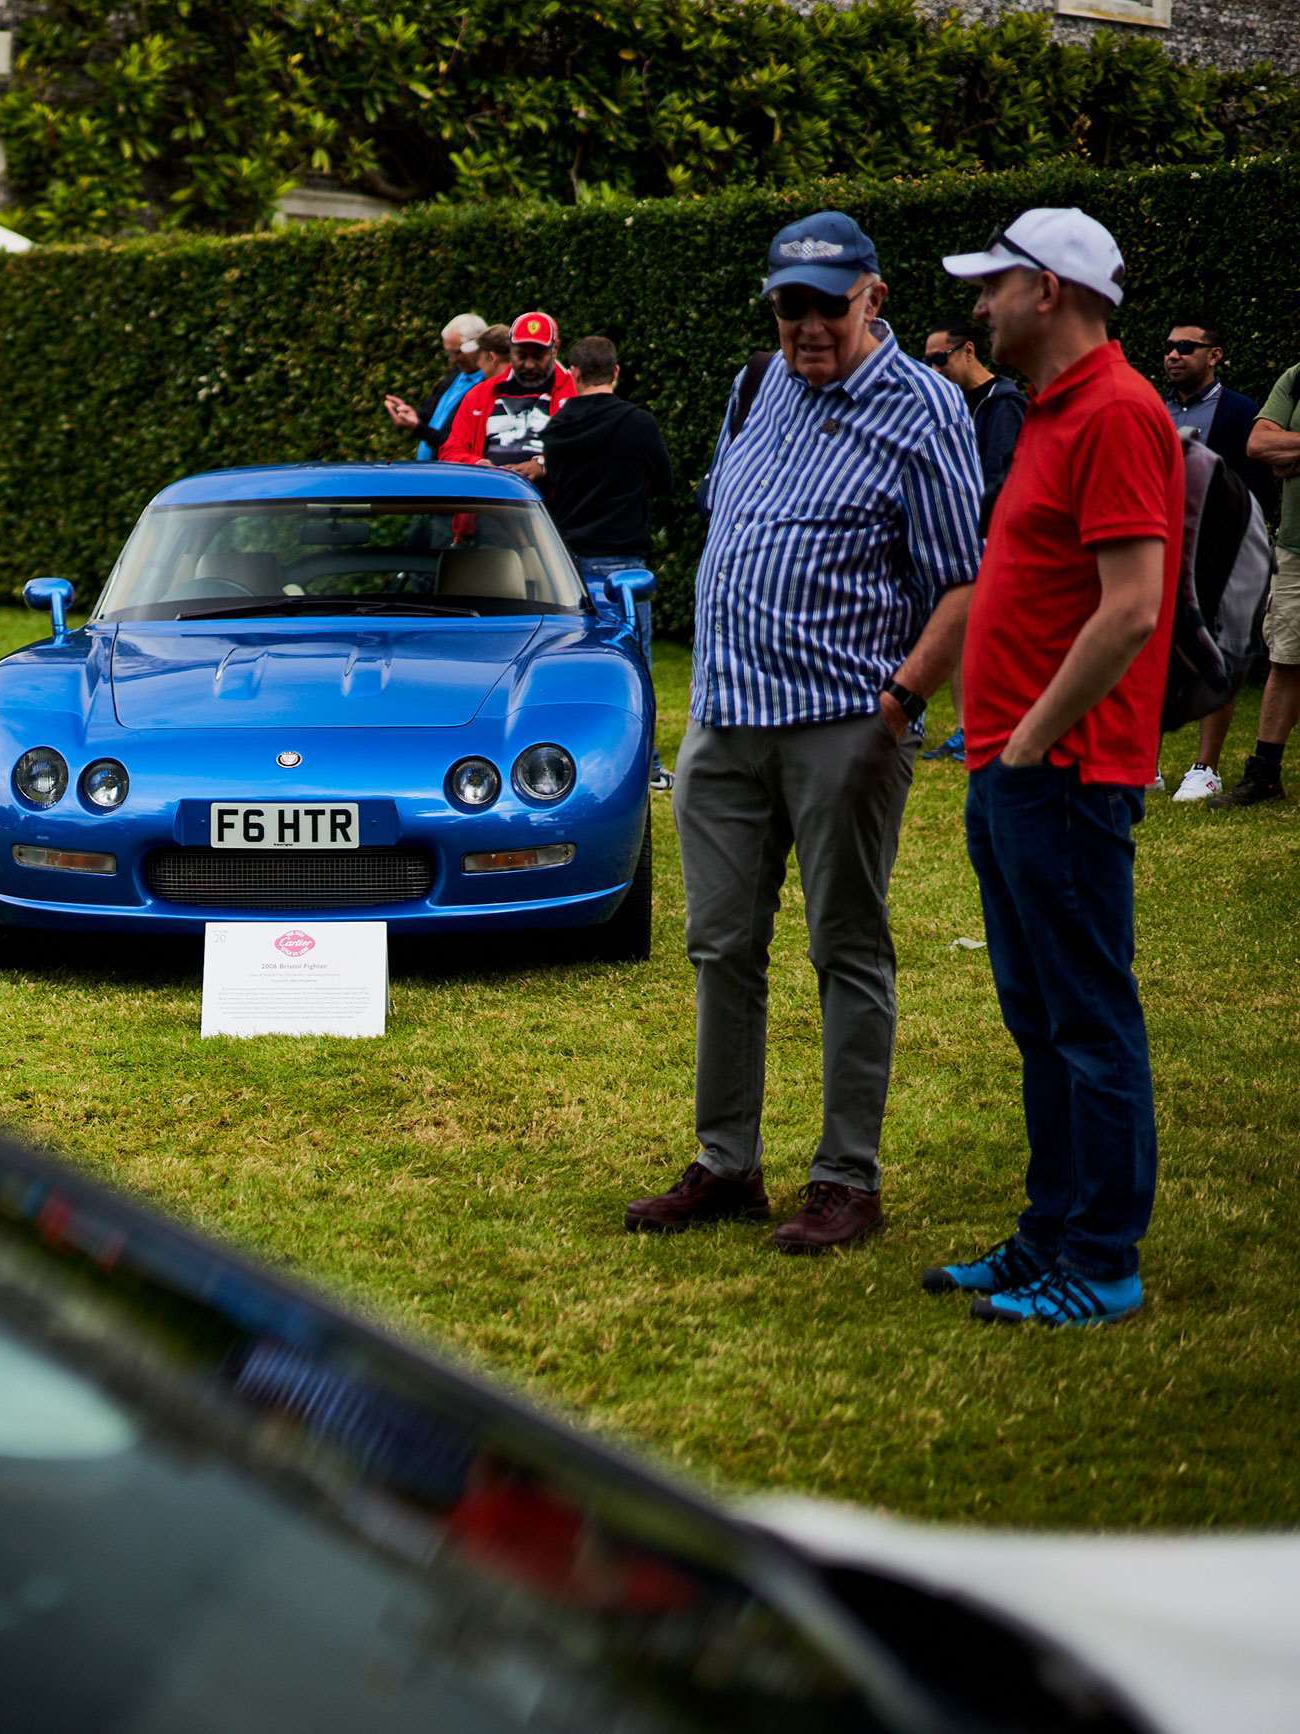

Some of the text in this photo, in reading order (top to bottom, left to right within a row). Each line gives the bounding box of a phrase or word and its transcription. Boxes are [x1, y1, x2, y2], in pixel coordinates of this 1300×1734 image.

[217, 809, 352, 843] F6 HTR
[279, 935, 313, 947] Cartier
